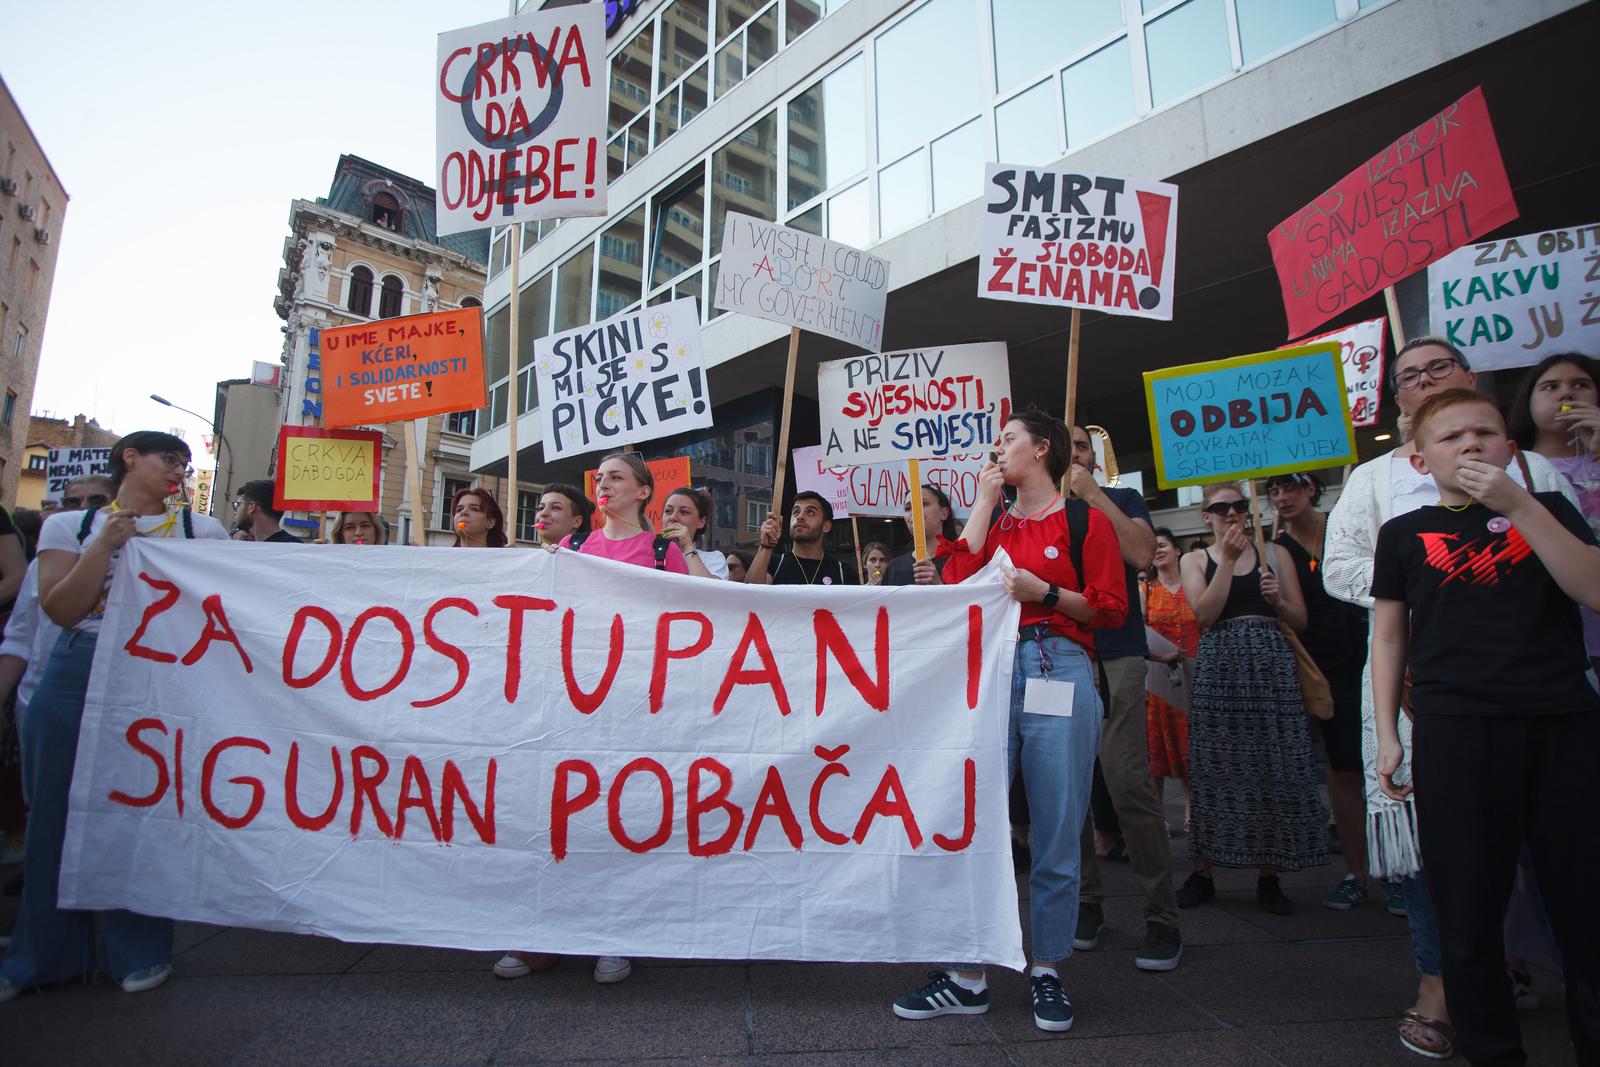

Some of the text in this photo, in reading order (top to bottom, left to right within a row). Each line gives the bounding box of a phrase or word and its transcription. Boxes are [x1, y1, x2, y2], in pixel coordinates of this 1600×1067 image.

[440, 23, 591, 104] CRKVA
[485, 96, 532, 142] DA
[441, 137, 597, 221] ODJEBE!
[987, 169, 1125, 216] SMRT
[1306, 143, 1446, 260] SAVJESTI
[1007, 213, 1135, 244] FAŠIZMU
[731, 218, 886, 290] I WISH I COULD
[1036, 242, 1150, 276] SLOBODA
[1292, 271, 1310, 298] U
[1312, 239, 1359, 285] NAMA
[1315, 200, 1472, 314] GADOSTI
[1473, 238, 1529, 267] ZA
[752, 254, 852, 301] ABORT
[1442, 261, 1560, 310] KAKVU
[327, 320, 465, 351] U IME MAJKE,
[551, 316, 644, 381] SKINI
[1446, 313, 1514, 347] KAD
[1521, 301, 1564, 350] JU
[337, 357, 467, 389] I SOLIDARNOSTI
[364, 380, 433, 406] SVETE!
[554, 342, 669, 401] MI SE S
[843, 350, 945, 389] PRIZIV
[1165, 363, 1323, 404] MOJ MOZAK
[552, 366, 706, 453] PIČKE!
[842, 375, 995, 427] SVJESNOSTI,
[1170, 387, 1328, 438] ODBIJA
[48, 449, 59, 463] U
[291, 443, 367, 466] CRKVA
[826, 427, 843, 456] A
[854, 427, 881, 453] NE
[1172, 422, 1312, 457] POVRATAK U
[1176, 437, 1345, 478] SREDNJI VIJEK
[49, 465, 85, 477] NEMA
[292, 465, 366, 482] DABOGDA
[125, 573, 982, 716] ZA DOSTUPAN I
[110, 719, 975, 860] SIGURAN POBAČAJ
